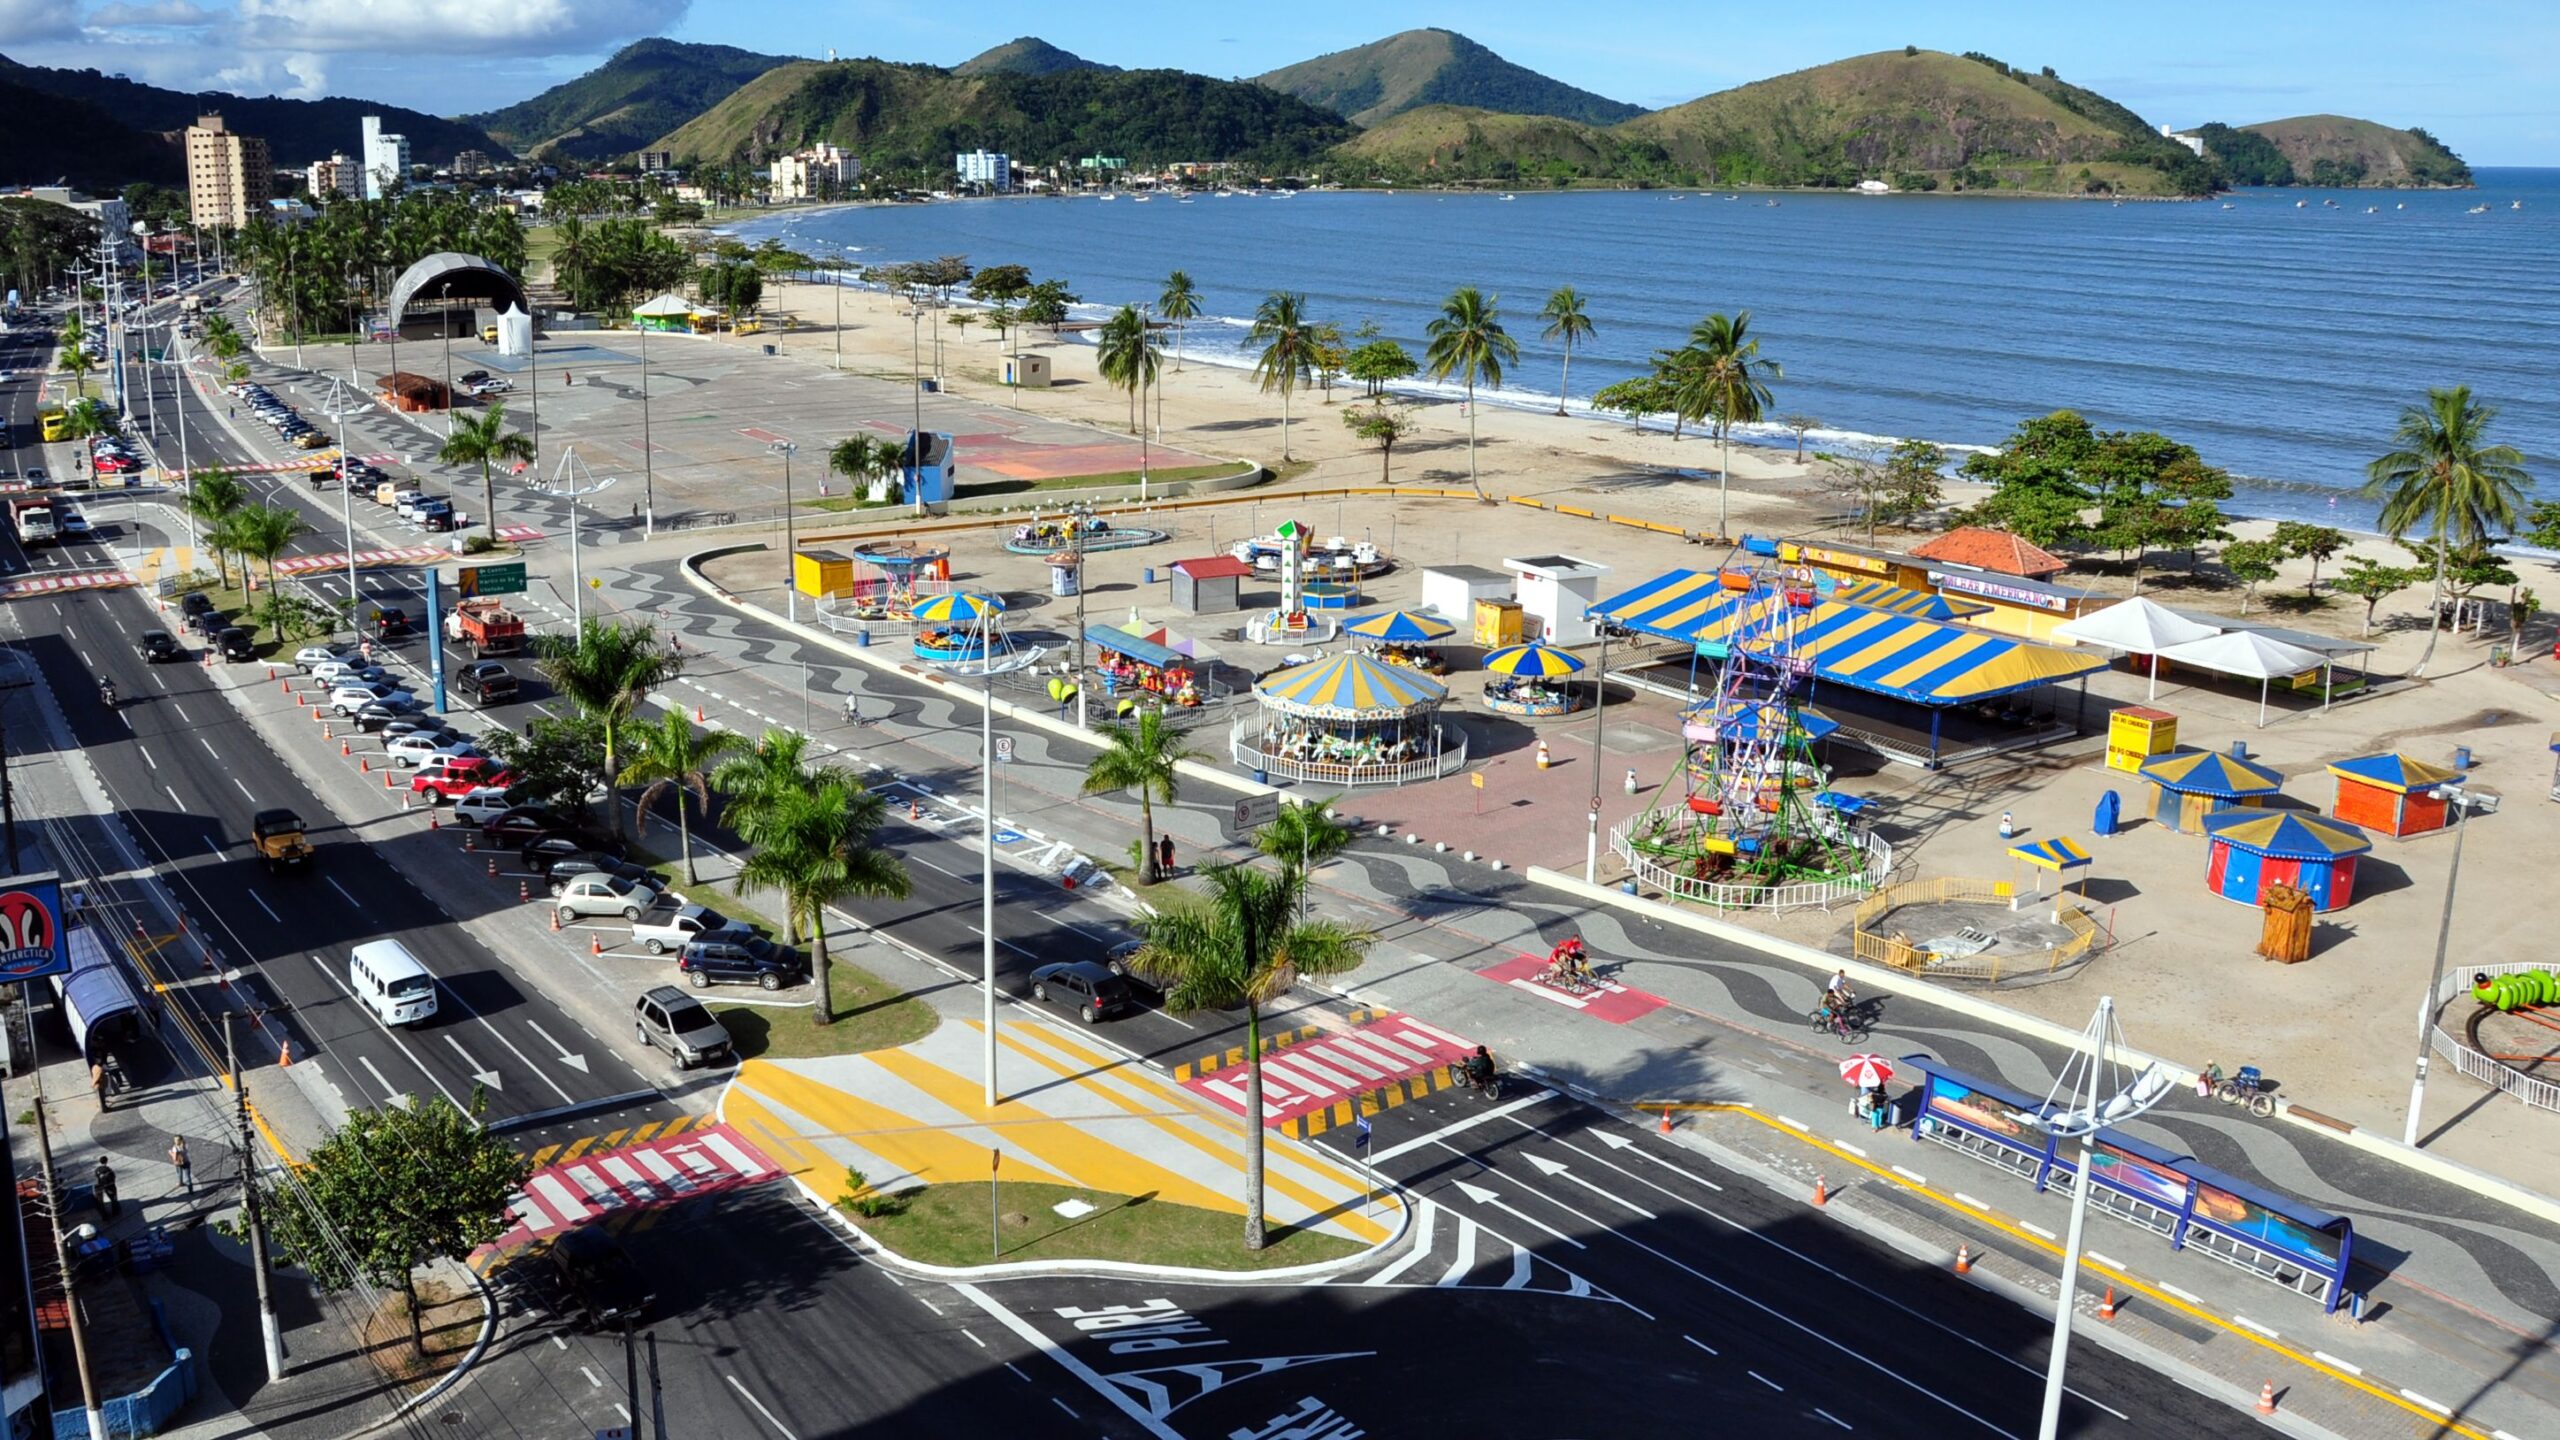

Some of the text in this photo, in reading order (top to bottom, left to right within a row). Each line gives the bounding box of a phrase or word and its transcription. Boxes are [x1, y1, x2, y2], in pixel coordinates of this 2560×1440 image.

[1982, 582, 2048, 606] AMERICANO
[0, 948, 50, 966] NTARCTICA
[1053, 1298, 1230, 1355] PARE
